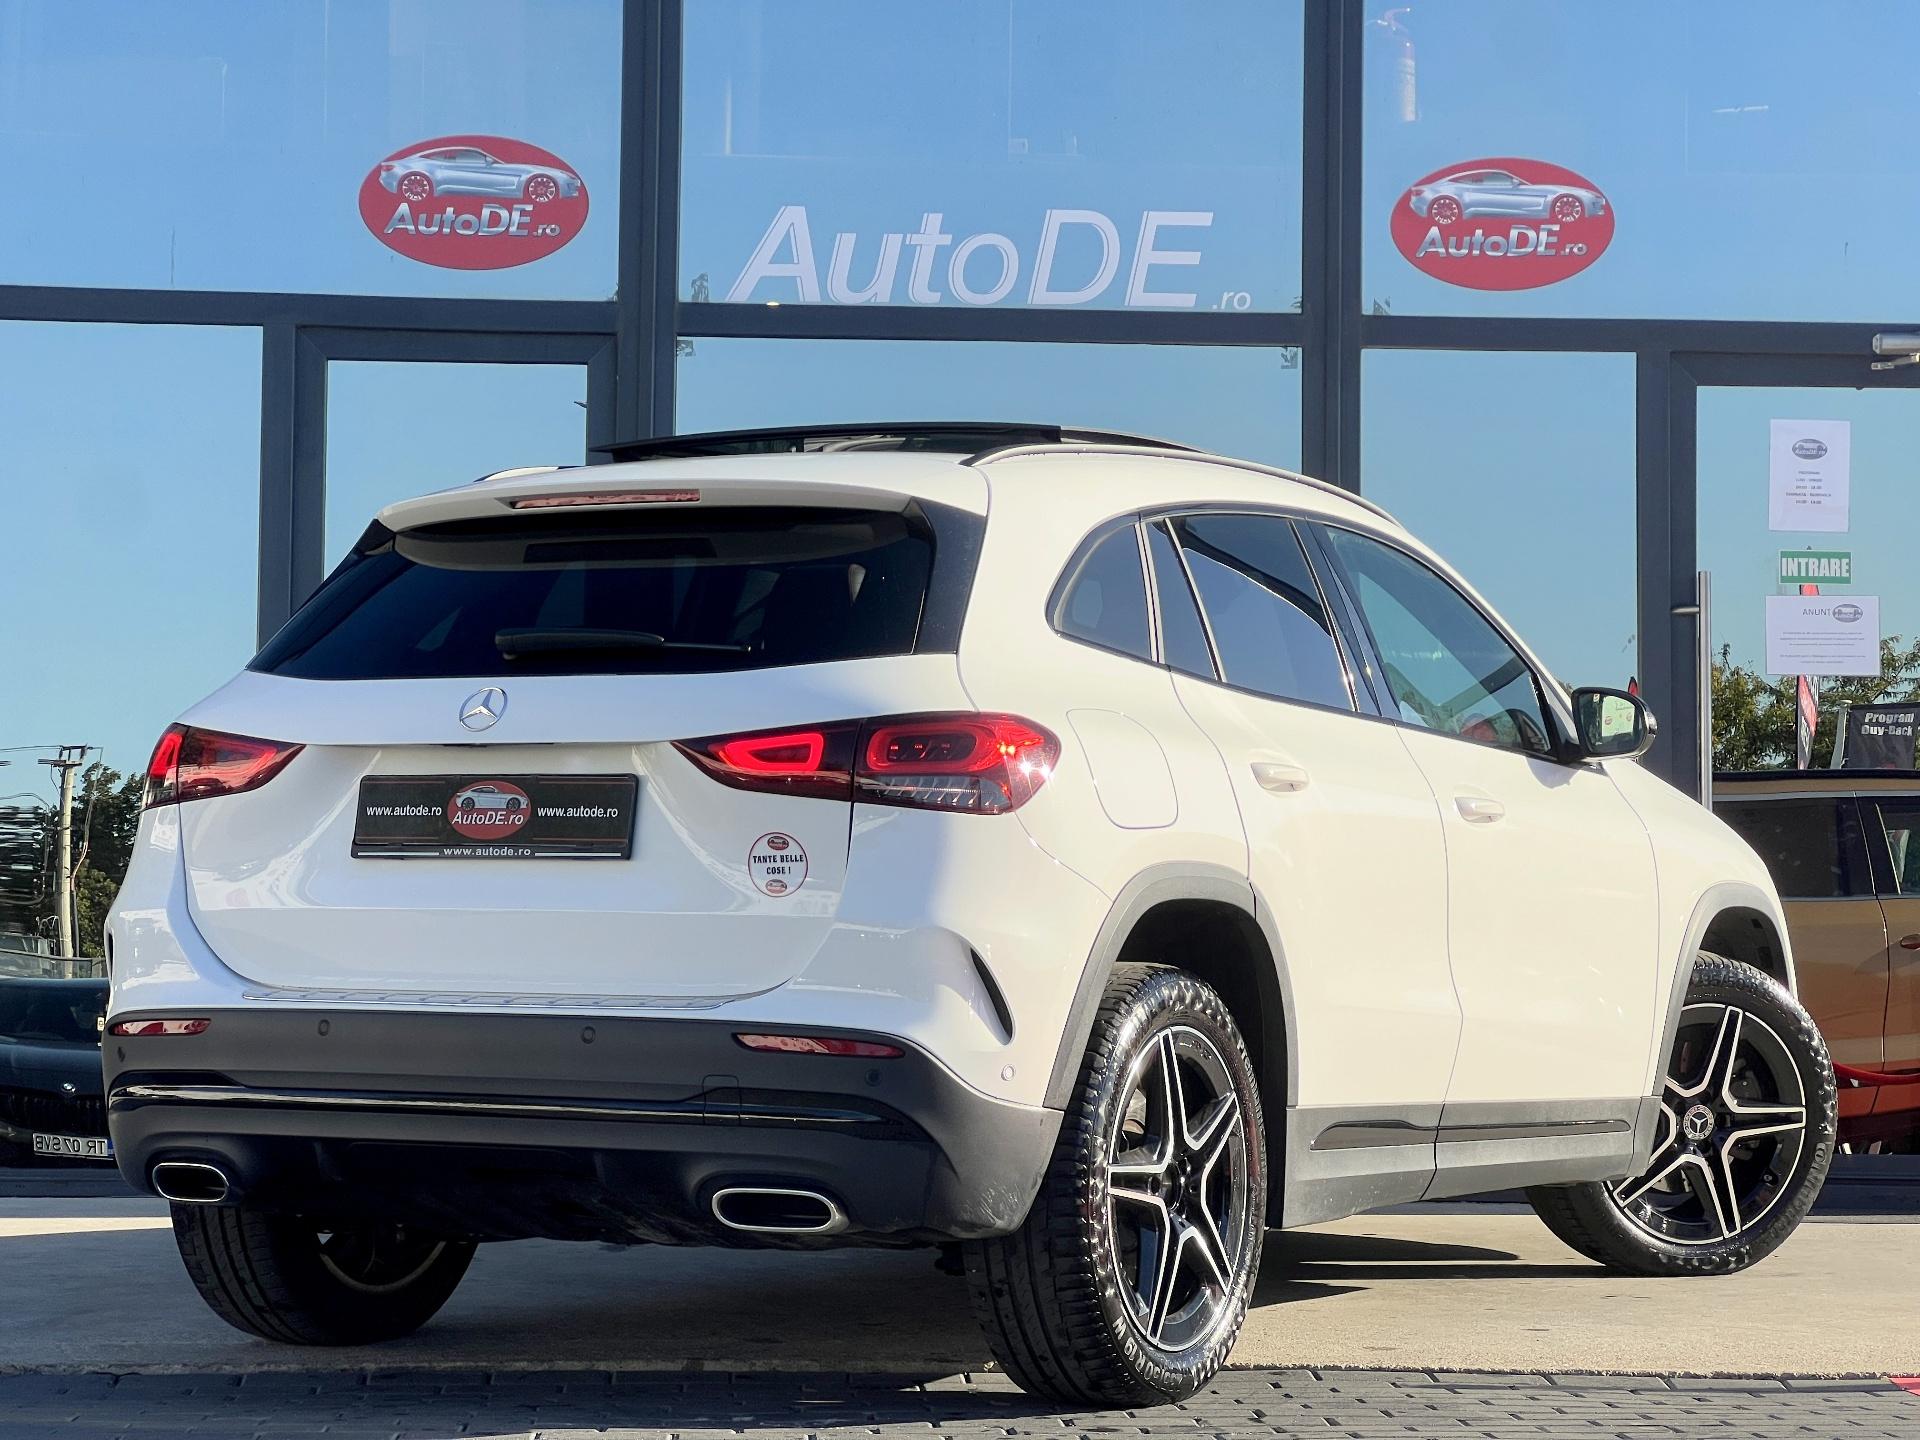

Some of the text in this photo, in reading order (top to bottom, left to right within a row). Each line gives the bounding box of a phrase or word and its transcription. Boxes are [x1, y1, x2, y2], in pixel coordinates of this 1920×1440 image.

[1781, 557, 1850, 577] INTRARE
[1864, 712, 1915, 724] Program
[366, 804, 442, 817] www.autode.ro
[537, 804, 619, 819] www.autode.ro
[451, 810, 525, 826] AutoDE.ro
[443, 846, 531, 857] www.autode.ro
[752, 854, 805, 864] TANTE BELLE
[766, 866, 786, 875] COSE
